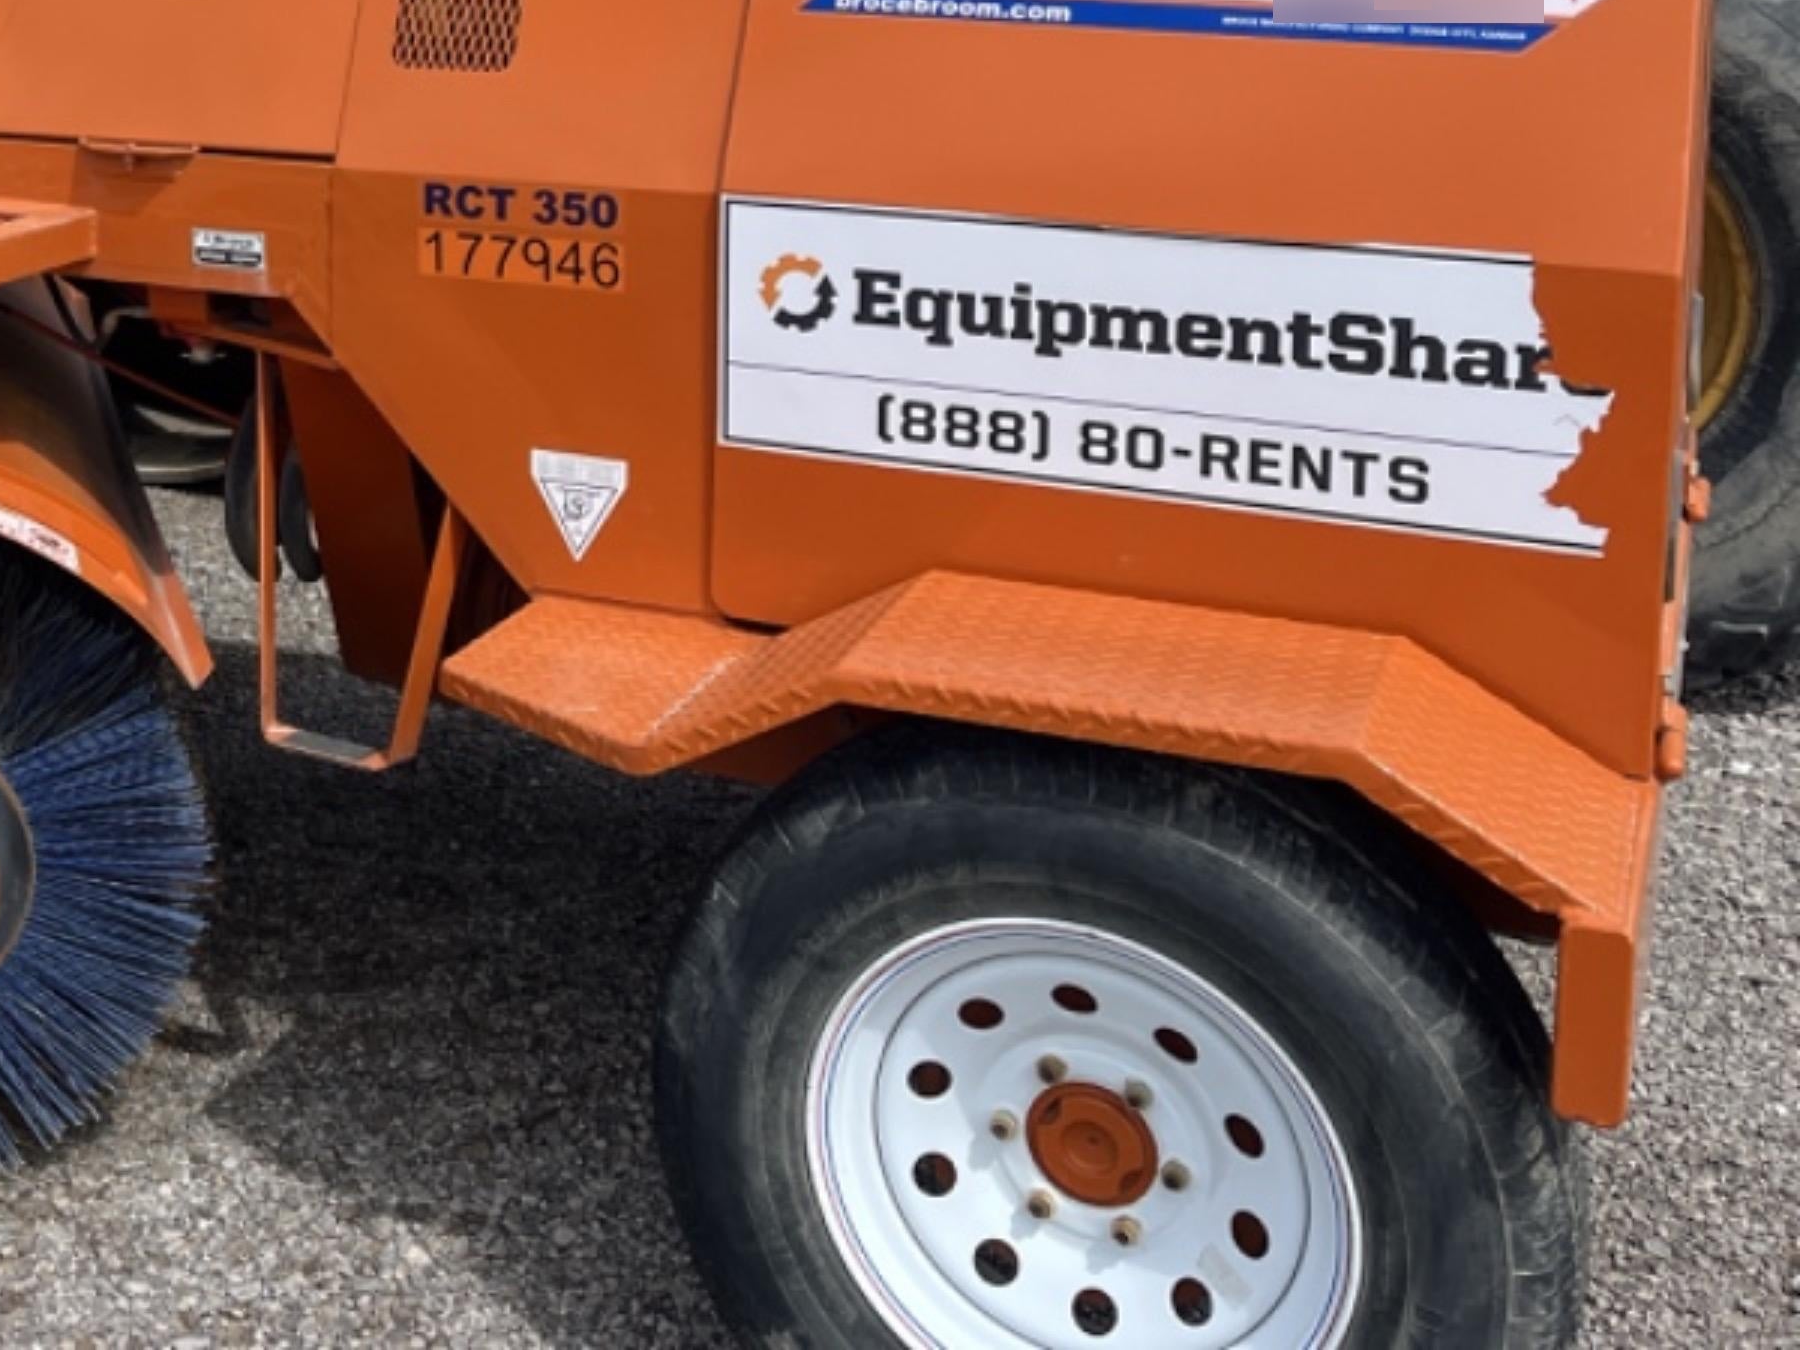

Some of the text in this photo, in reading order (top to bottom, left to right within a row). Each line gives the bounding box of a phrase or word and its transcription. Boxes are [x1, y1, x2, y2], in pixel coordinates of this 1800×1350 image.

[423, 182, 620, 229] RCT 350
[424, 230, 621, 290] 177946
[851, 268, 1609, 397] EquipmentShar
[876, 394, 1431, 505] (888) 80-RENTS
